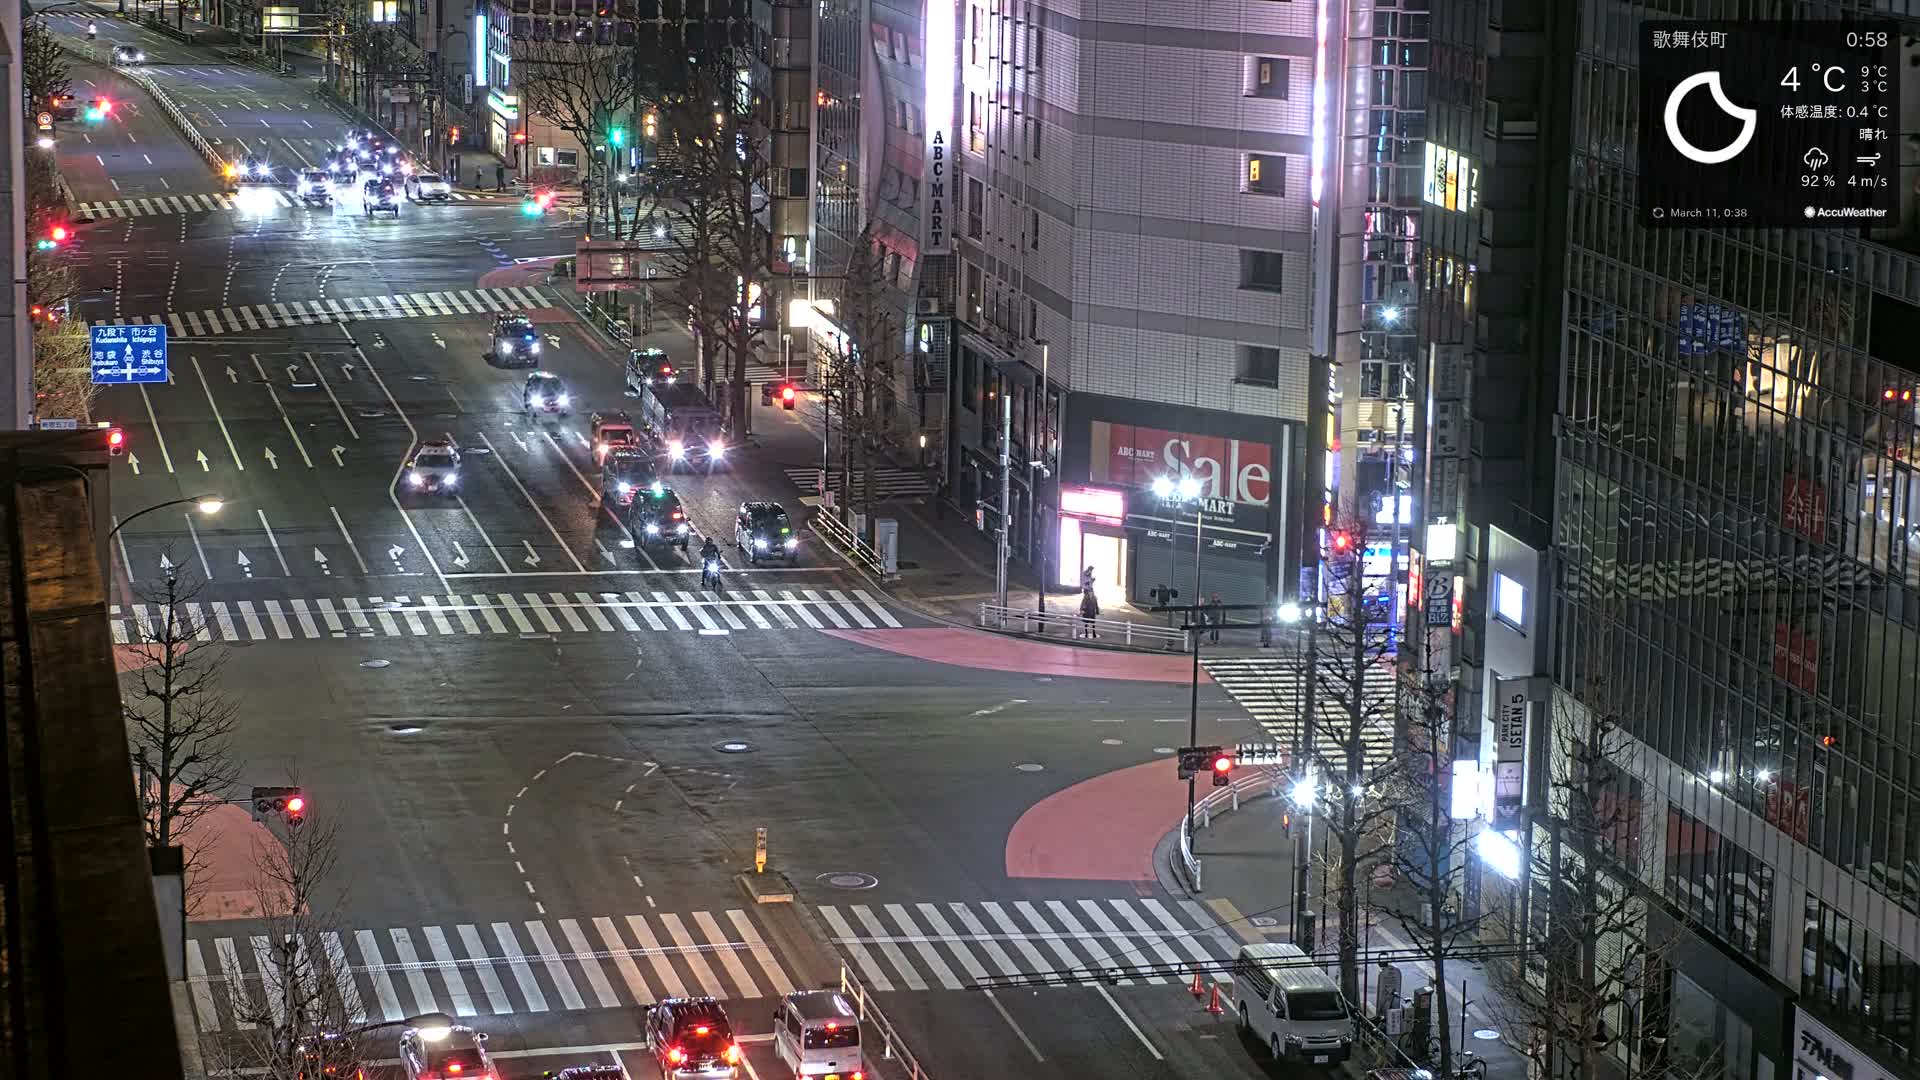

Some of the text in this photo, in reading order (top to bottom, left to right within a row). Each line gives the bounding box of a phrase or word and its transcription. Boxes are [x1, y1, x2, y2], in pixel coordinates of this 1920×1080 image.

[98, 327, 126, 337] 九段下
[132, 336, 157, 344] Ichigaya
[94, 349, 164, 360] 池袋 渋谷
[141, 358, 164, 366] Shibuya
[1163, 438, 1271, 508] Sale
[1501, 704, 1510, 743] PARK CITY
[1509, 694, 1524, 748] ISETAN 5
